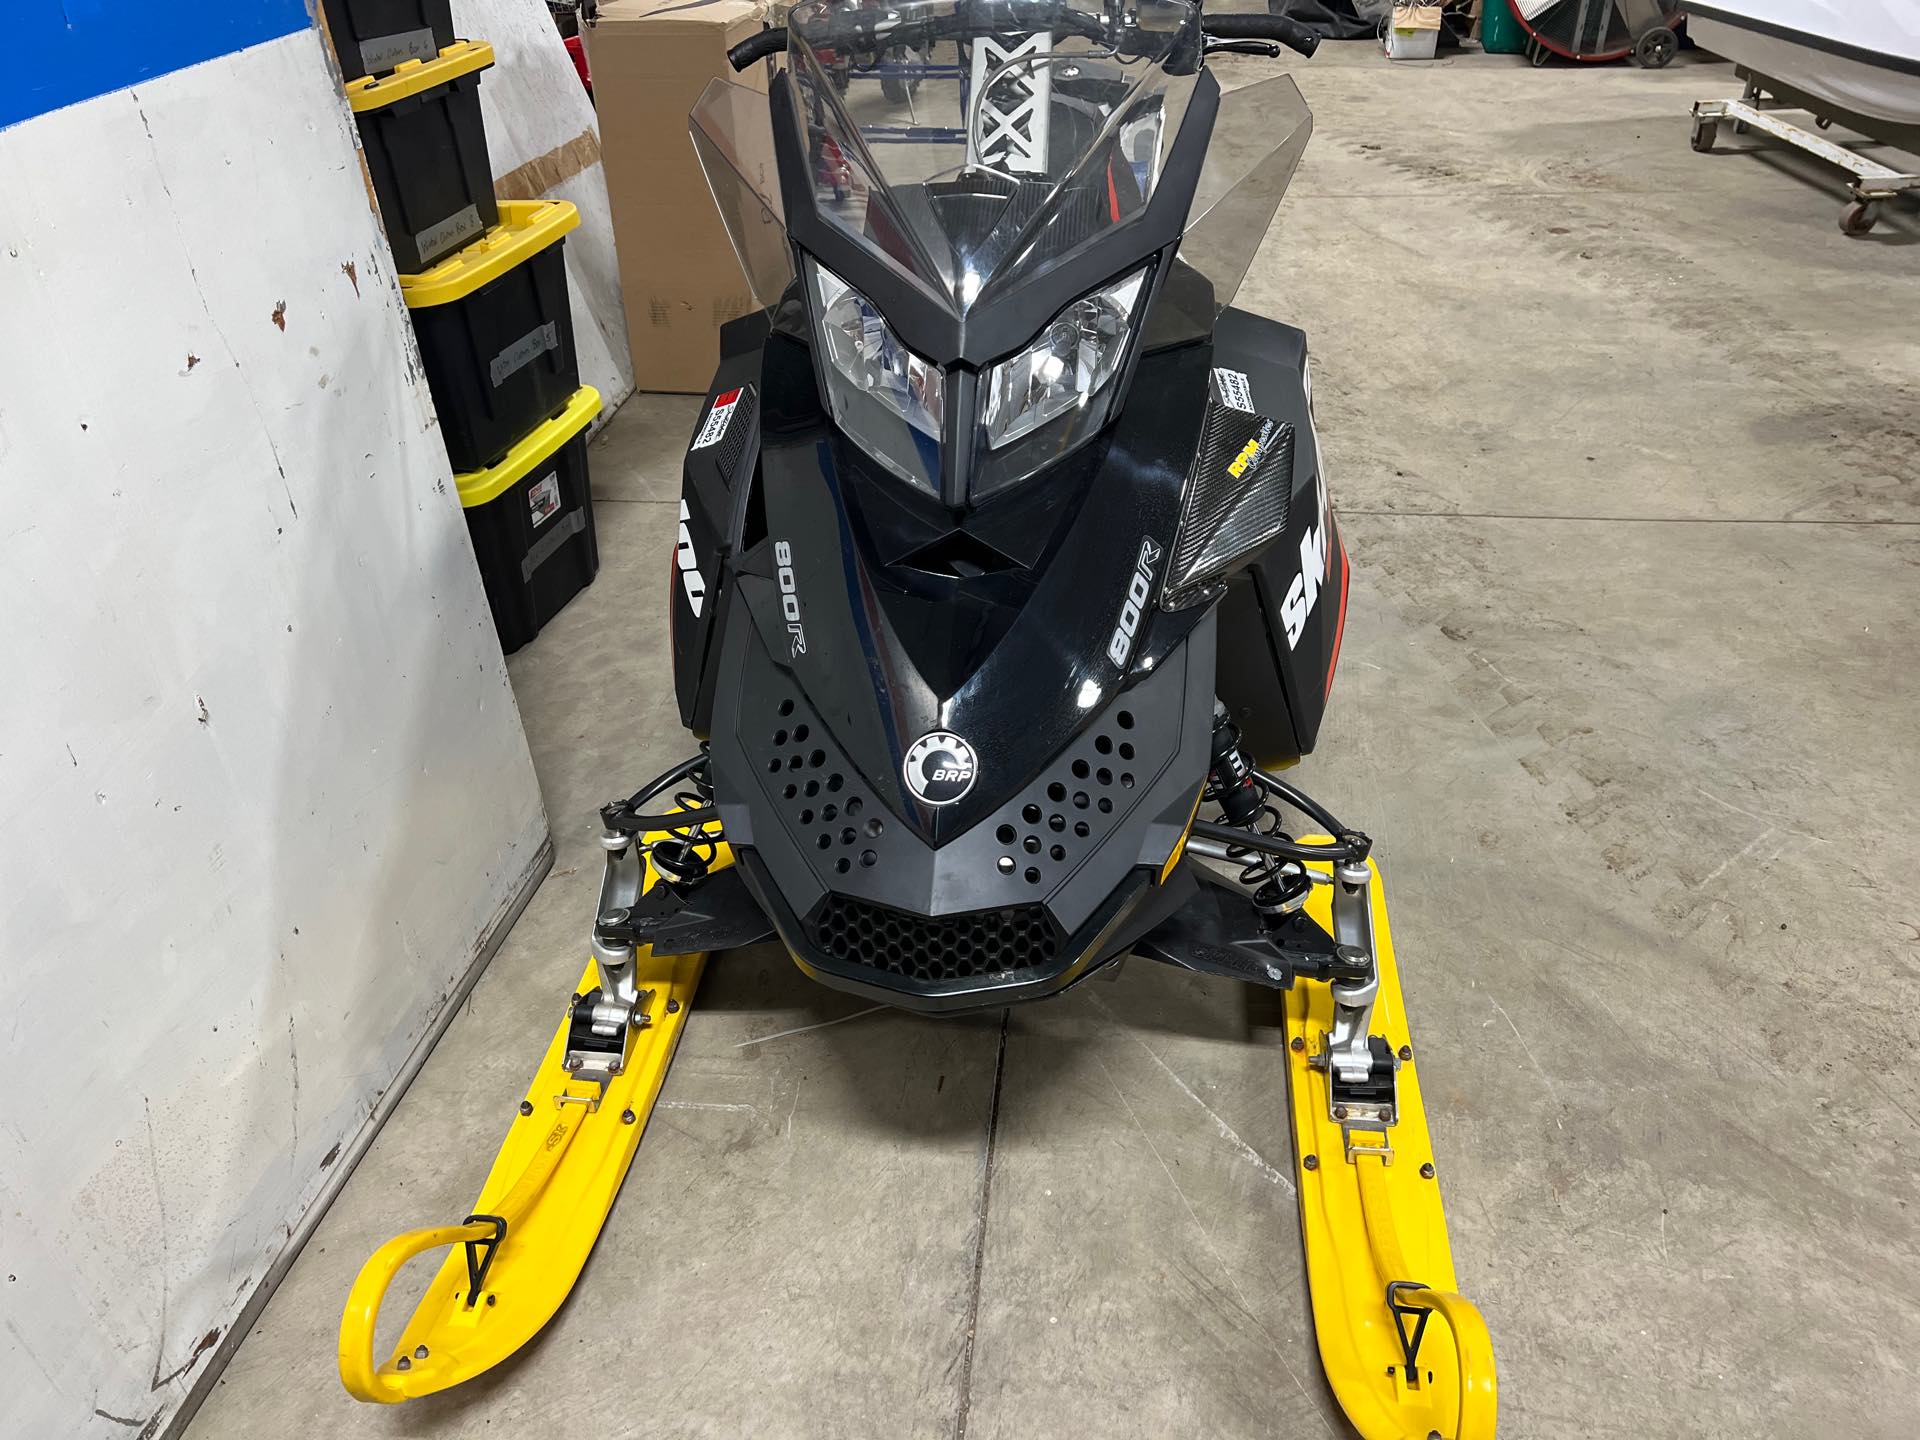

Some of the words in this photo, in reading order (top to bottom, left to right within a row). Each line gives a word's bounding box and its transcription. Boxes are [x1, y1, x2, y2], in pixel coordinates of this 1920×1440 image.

[1228, 373, 1248, 410] S55482
[1227, 438, 1260, 479] RPM
[774, 541, 807, 659] 800R
[1109, 540, 1162, 667] 800R
[931, 769, 972, 782] BRP
